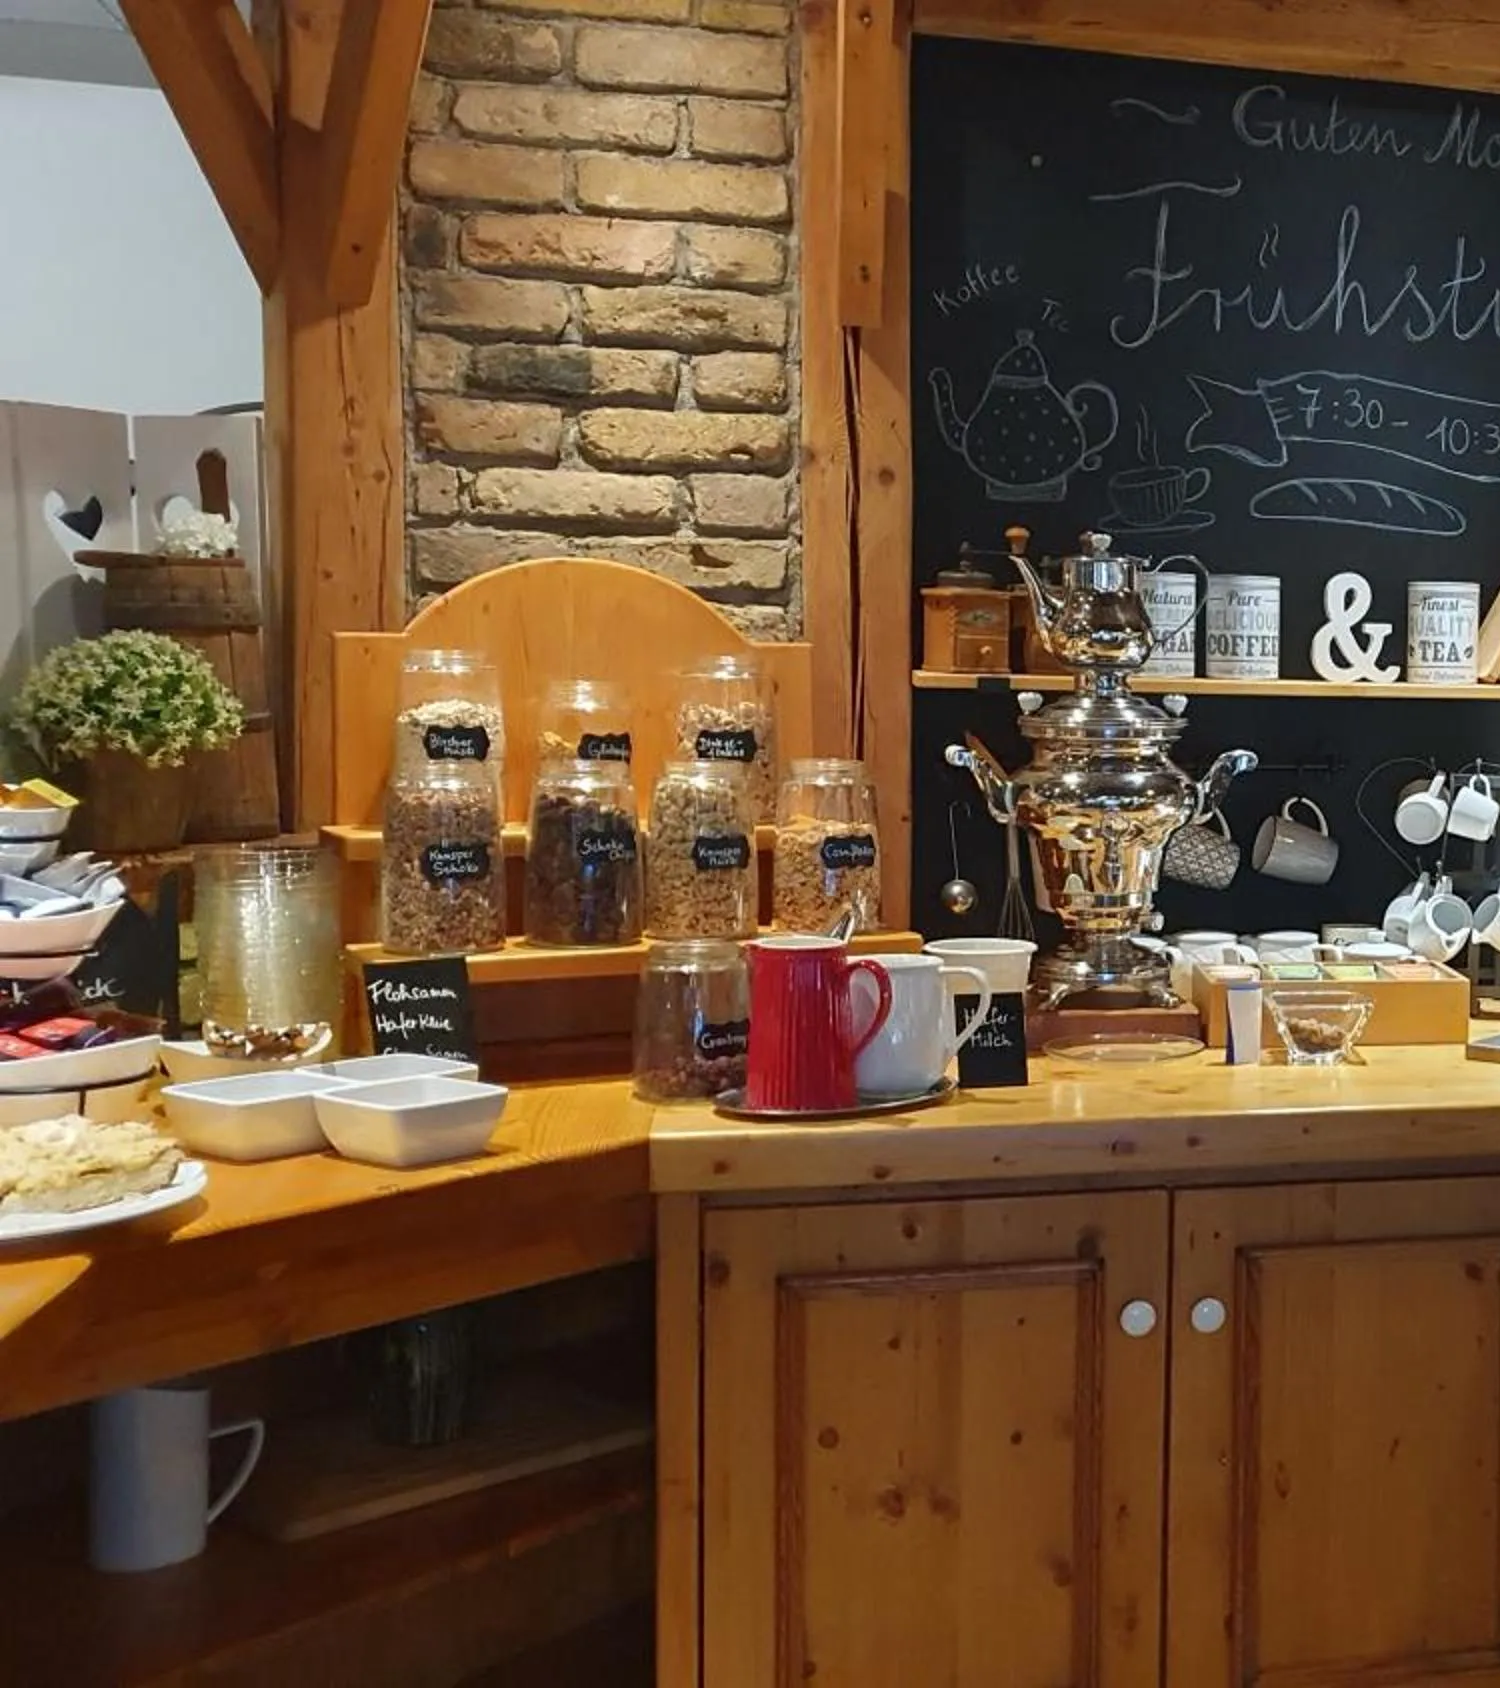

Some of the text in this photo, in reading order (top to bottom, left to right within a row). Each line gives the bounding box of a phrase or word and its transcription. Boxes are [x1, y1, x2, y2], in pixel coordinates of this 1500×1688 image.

[1232, 84, 1411, 158] Guten
[1226, 589, 1262, 607] Pure
[1418, 640, 1462, 663] TEA
